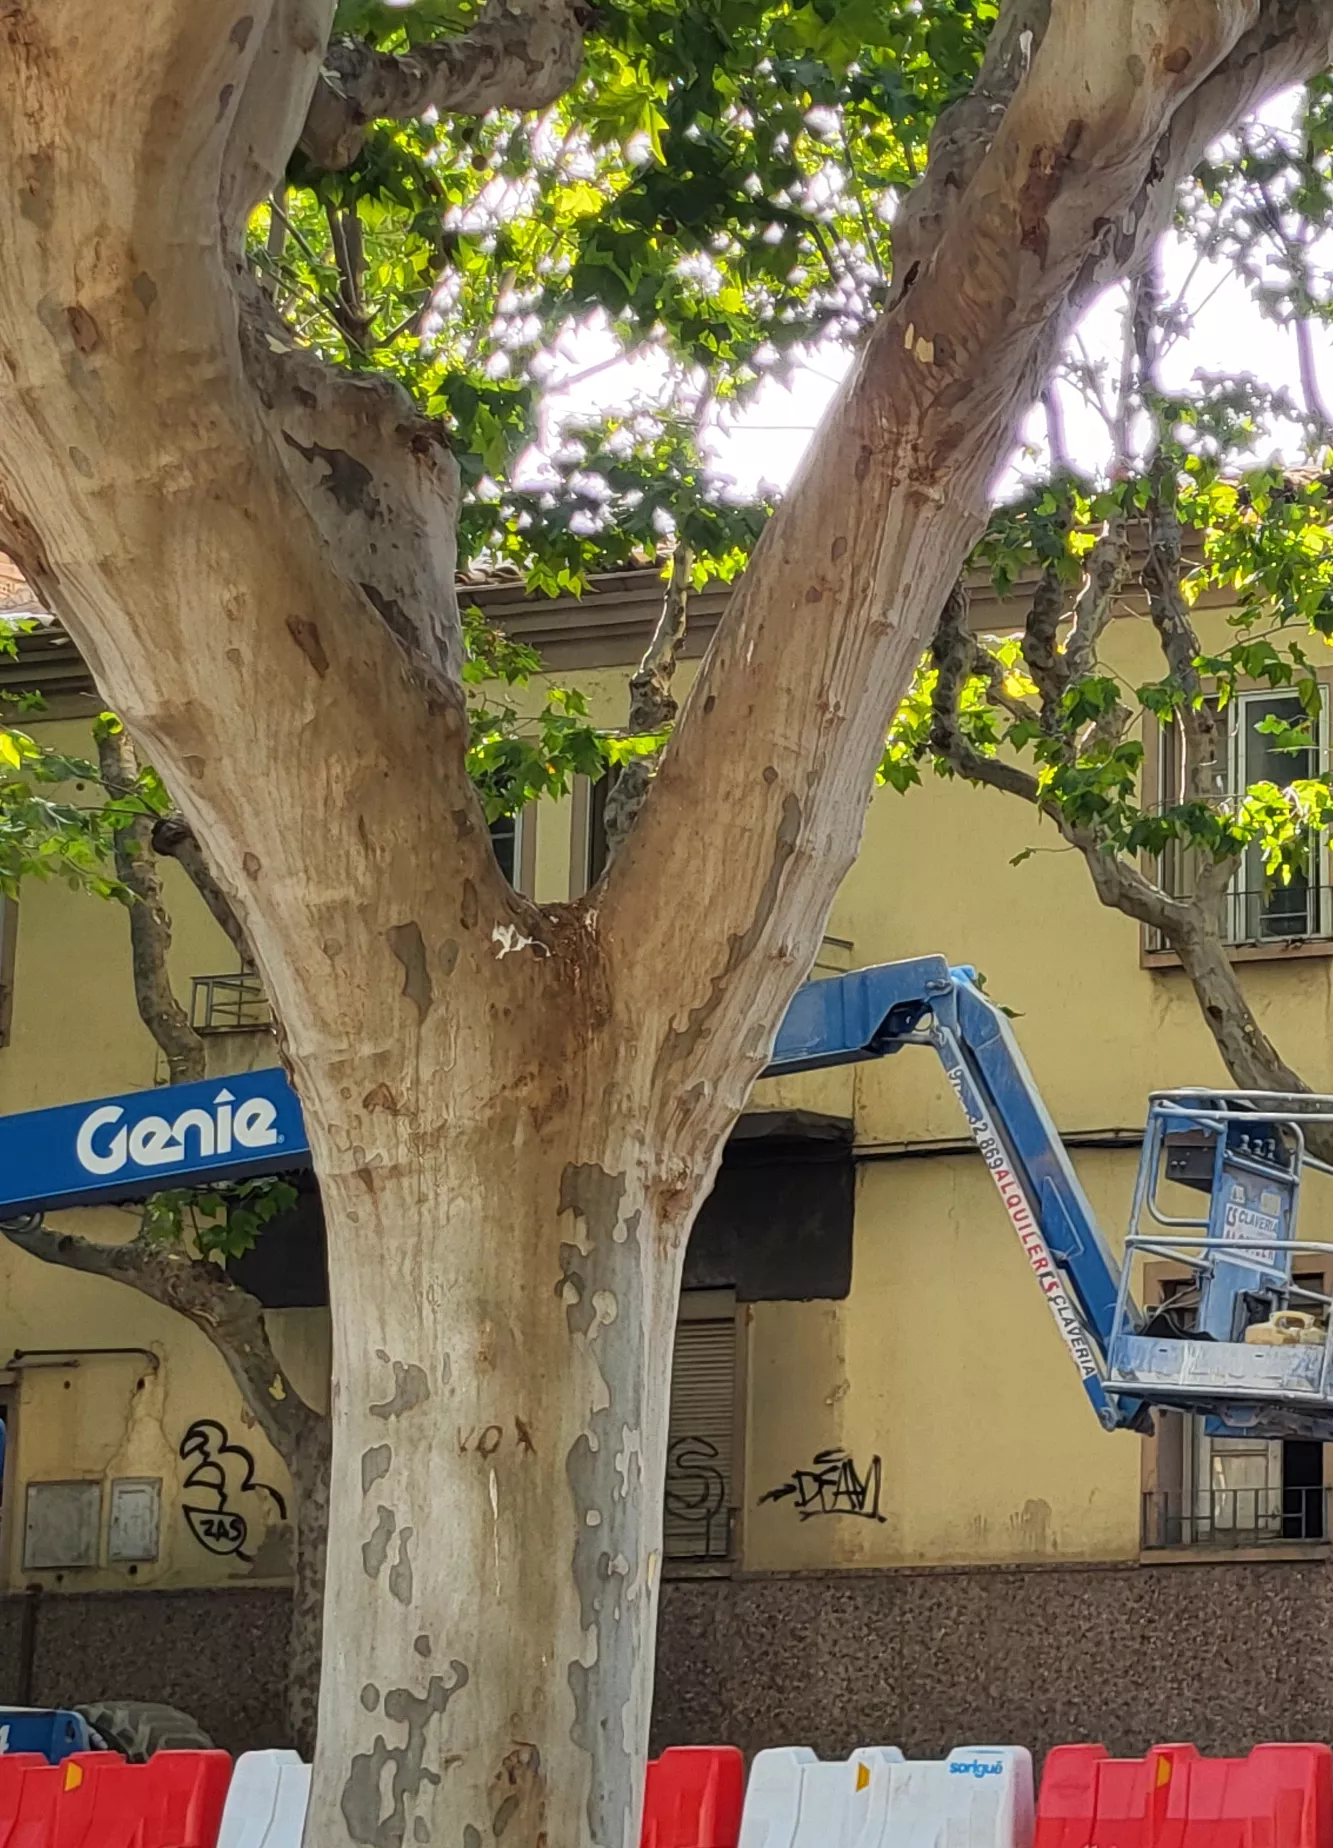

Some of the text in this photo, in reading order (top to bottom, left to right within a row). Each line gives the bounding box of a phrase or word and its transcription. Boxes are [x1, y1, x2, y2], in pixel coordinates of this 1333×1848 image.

[76, 1087, 278, 1175] Genie
[979, 1137, 1005, 1171] 869
[994, 1168, 1050, 1275] ALQUILER
[1049, 1294, 1097, 1378] CLAVERIA
